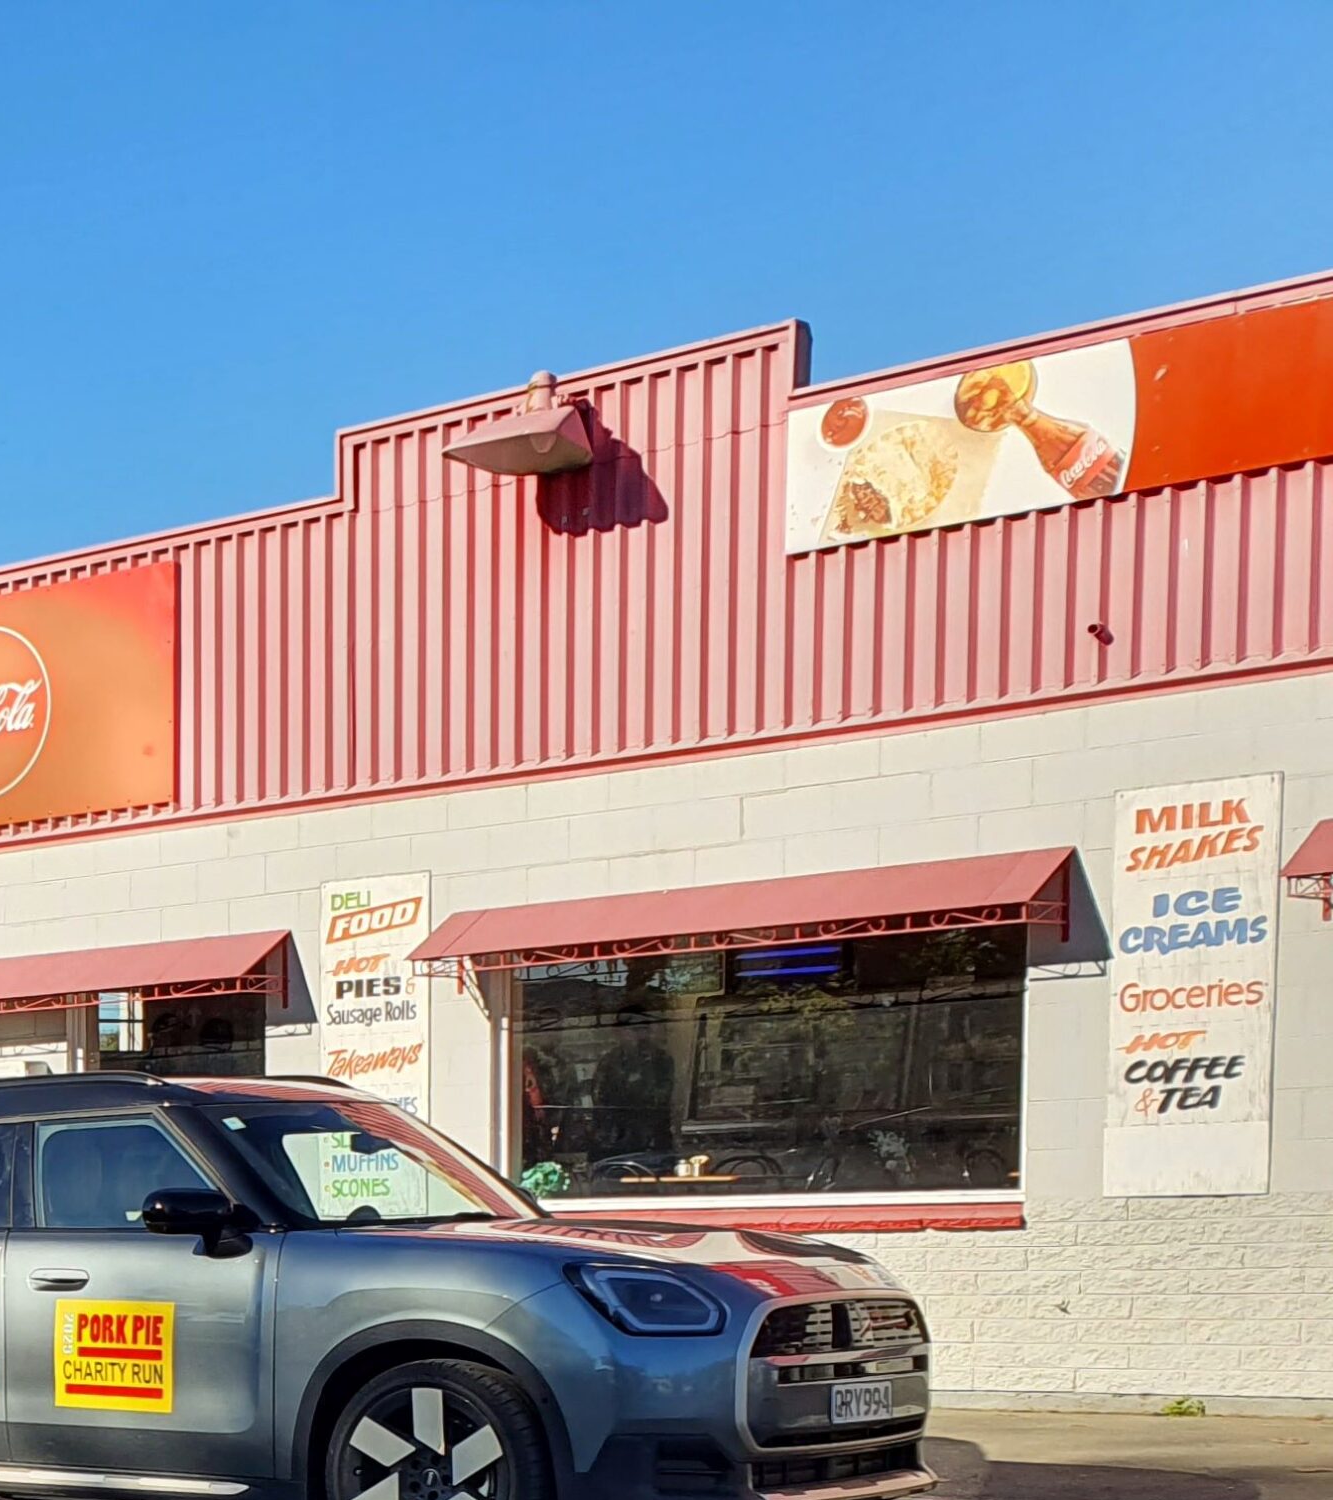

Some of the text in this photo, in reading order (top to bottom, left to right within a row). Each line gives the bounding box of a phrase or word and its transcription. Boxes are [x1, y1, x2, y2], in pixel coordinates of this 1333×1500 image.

[1135, 798, 1251, 834] MILK
[1125, 825, 1264, 872] SHAKES
[330, 890, 371, 912] DELI
[1152, 886, 1242, 918] ICE
[333, 901, 416, 940] FOOD
[1119, 915, 1268, 956] CREAMS
[325, 953, 391, 976] HOT
[335, 976, 401, 1000] PIES
[1119, 978, 1264, 1013] Groceries
[326, 1000, 417, 1027] Sausage Rolls
[1115, 1029, 1207, 1054] HOT
[327, 1040, 425, 1080] Takeaways
[1124, 1055, 1246, 1085] COFFEE
[331, 1153, 400, 1173] MUFFINS
[331, 1178, 391, 1198] SCONES
[77, 1313, 164, 1346] PORK PIE
[62, 1360, 164, 1385] CHARITY RUN
